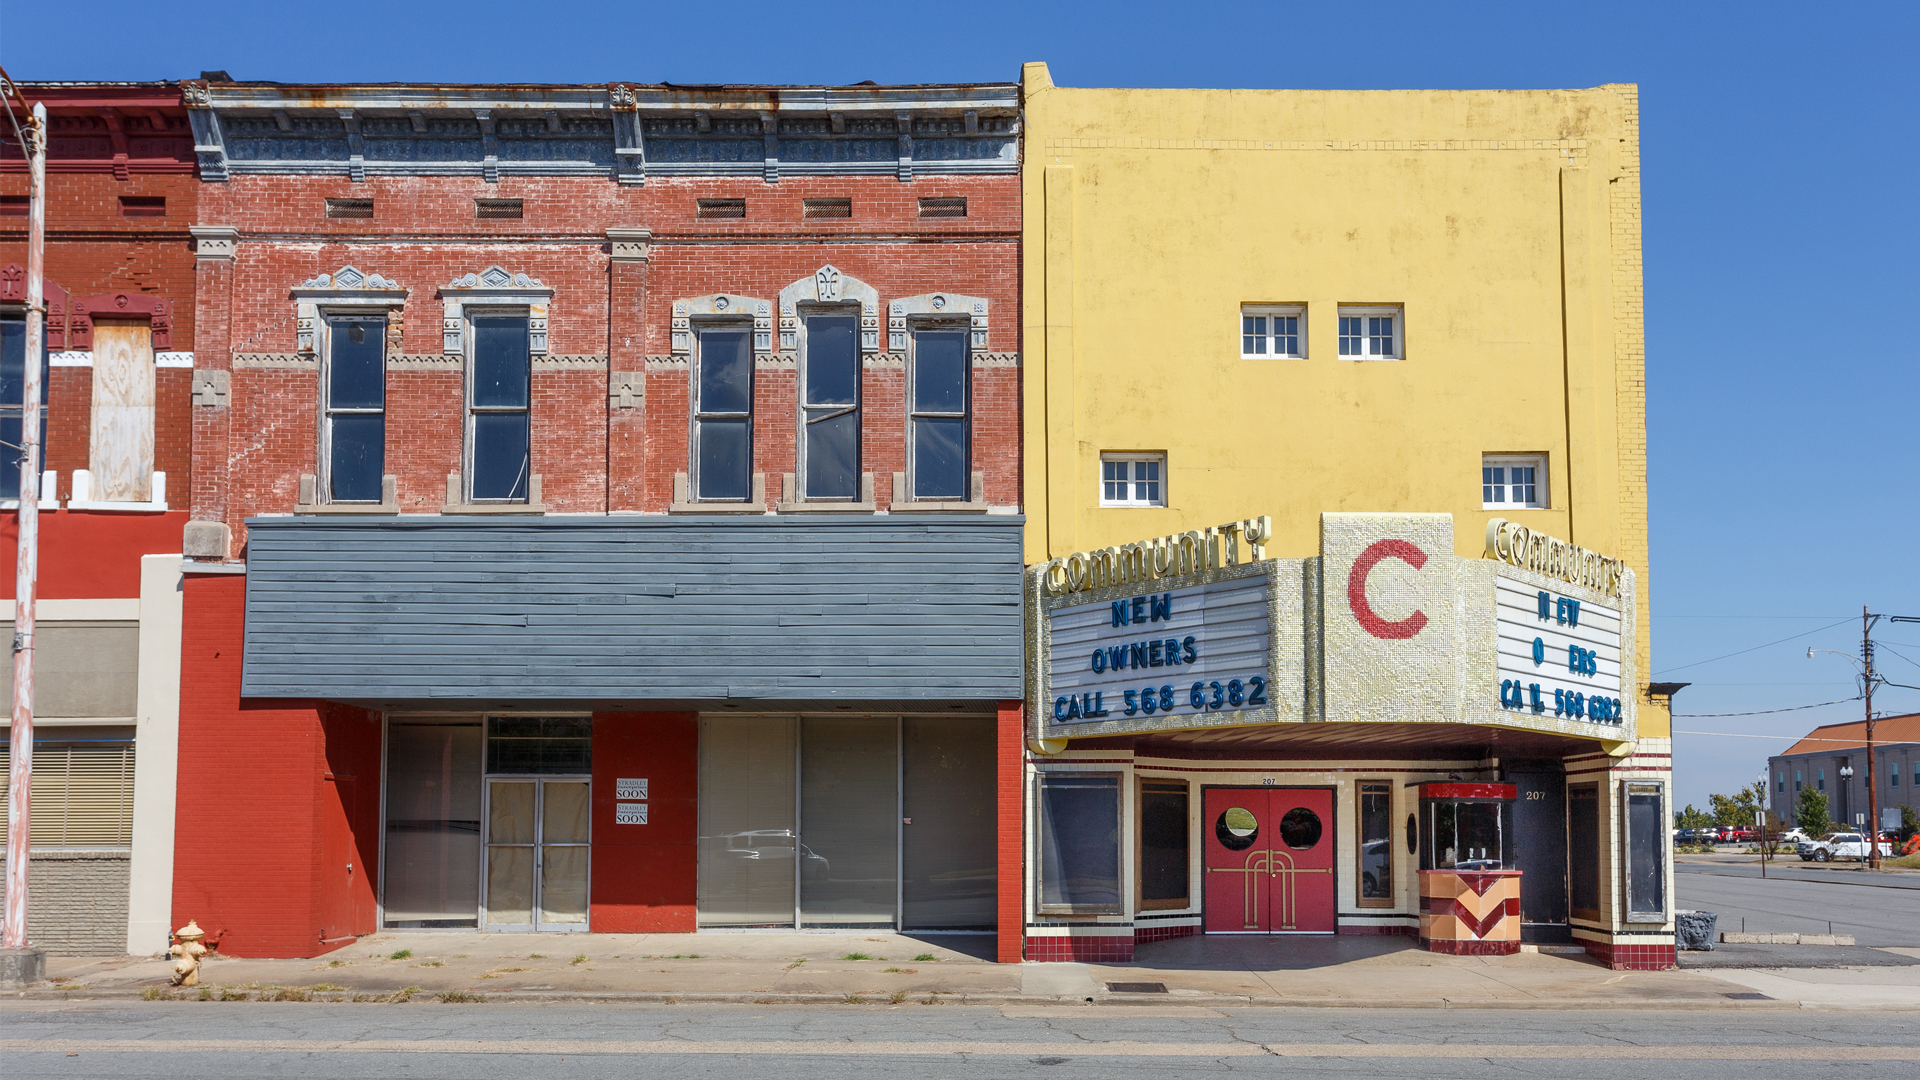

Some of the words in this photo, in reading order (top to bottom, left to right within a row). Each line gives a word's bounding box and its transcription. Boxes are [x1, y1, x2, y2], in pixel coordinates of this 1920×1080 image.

[1348, 539, 1429, 639] C
[1111, 593, 1171, 628] NEW
[1091, 636, 1197, 674] OWNERS
[1055, 690, 1108, 722] CALL
[1123, 685, 1175, 716] 568
[1190, 676, 1267, 710] 6382
[1555, 688, 1585, 718] 568
[616, 790, 646, 798] SOON
[1526, 791, 1546, 800] 207
[616, 814, 646, 823] SOON
